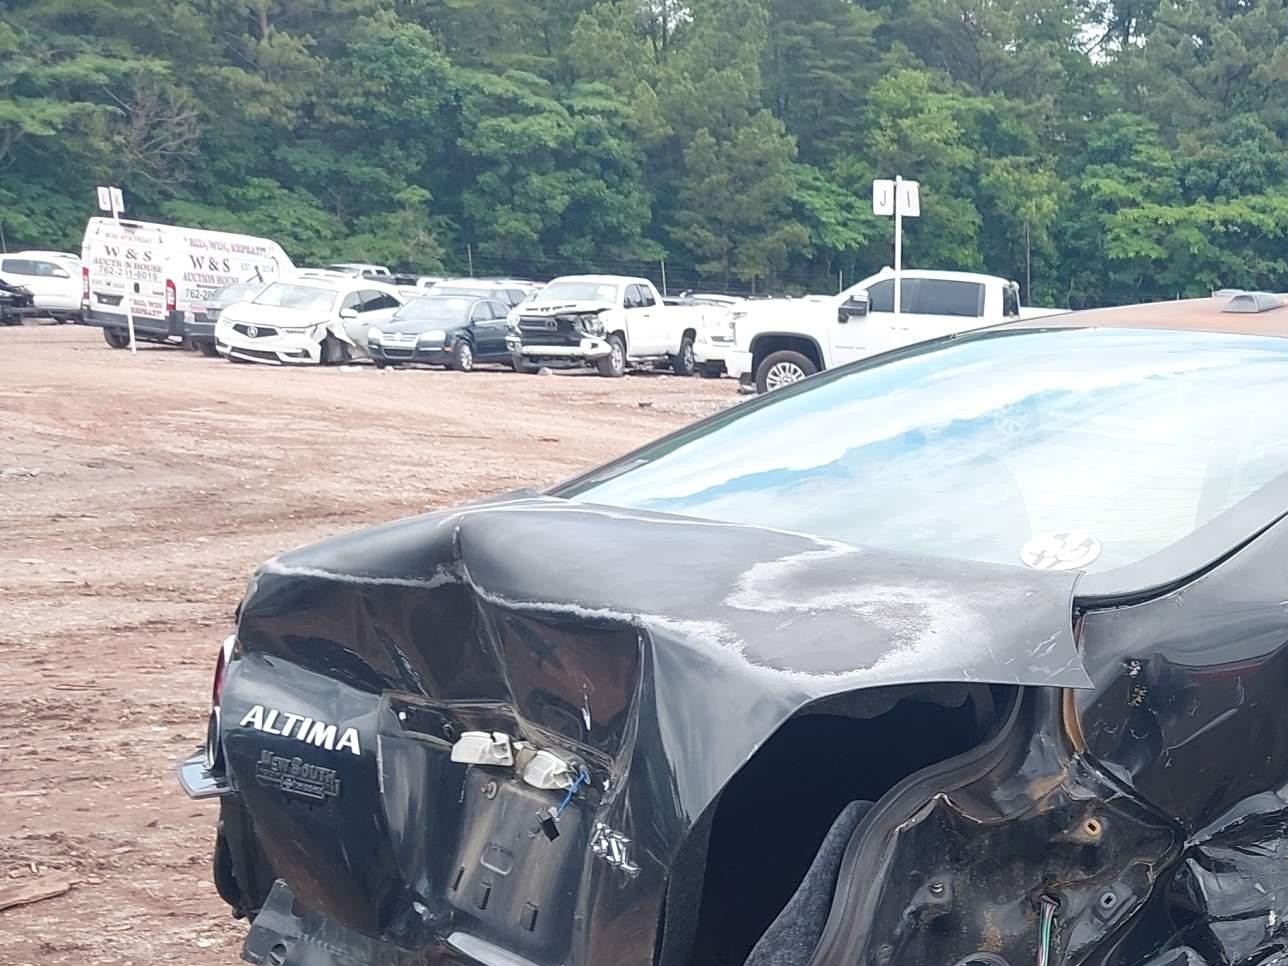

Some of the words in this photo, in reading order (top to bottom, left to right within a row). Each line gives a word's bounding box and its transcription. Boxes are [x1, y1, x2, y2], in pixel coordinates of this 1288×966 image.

[879, 190, 887, 207] J
[104, 244, 120, 257] W
[125, 248, 138, 261] &
[142, 250, 153, 262] S
[189, 254, 205, 270] W
[208, 256, 219, 272] &
[222, 258, 231, 273] S
[183, 271, 216, 284] AUCTION
[240, 704, 362, 756] ALTIMA
